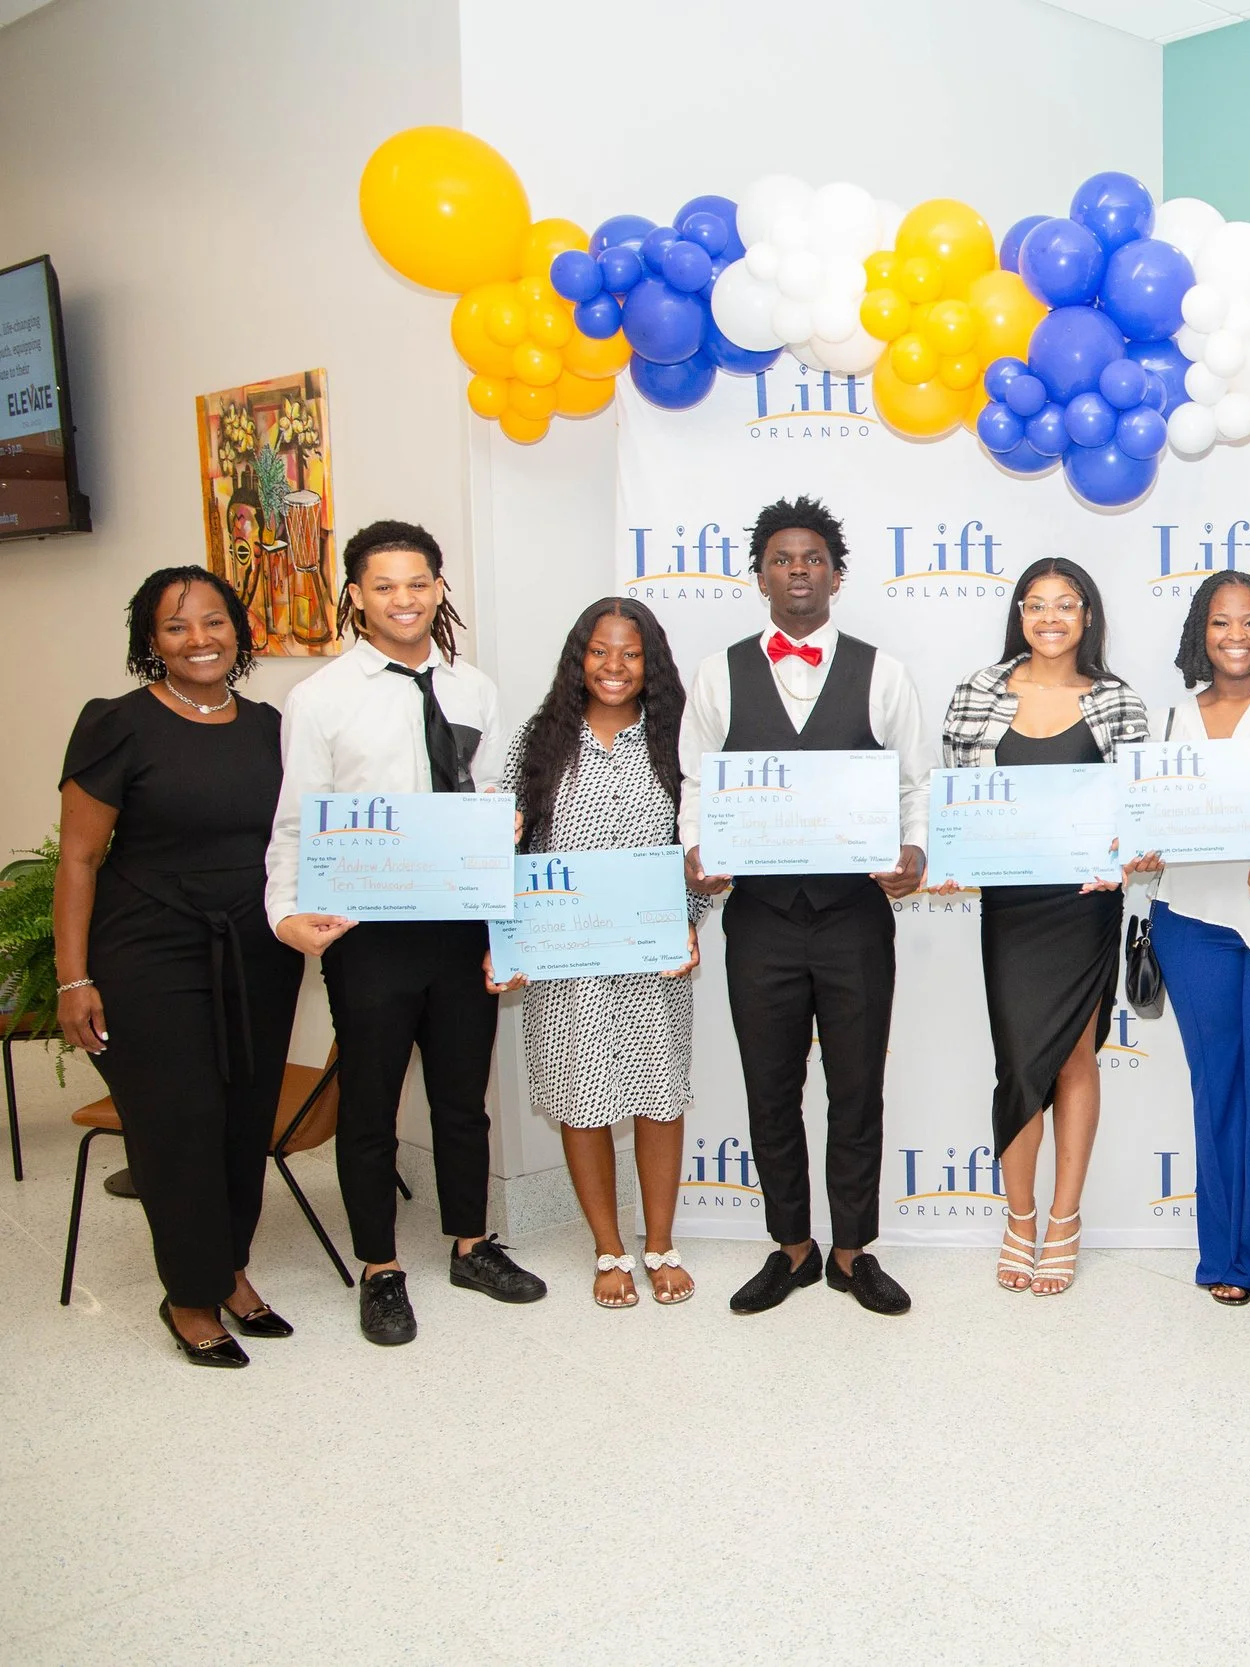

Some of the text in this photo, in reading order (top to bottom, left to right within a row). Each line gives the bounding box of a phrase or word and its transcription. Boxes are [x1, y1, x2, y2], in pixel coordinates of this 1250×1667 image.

[755, 364, 868, 418] Lift
[8, 384, 52, 416] ELEVATE
[750, 426, 869, 438] ORLANDO
[628, 523, 741, 578] Lift
[886, 520, 1004, 578] Lift
[628, 587, 743, 599] ORLANDO
[887, 586, 1005, 598] ORLANDO
[1129, 744, 1205, 781] Lift
[713, 756, 793, 791] Lift
[942, 770, 1017, 805] Lift
[1128, 782, 1206, 794] ORLANDO
[712, 795, 793, 804] ORLANDO
[314, 796, 400, 832] Lift
[940, 808, 1018, 817] ORLANDO
[312, 838, 401, 847] ORLANDO
[327, 875, 414, 892] Ten Thousand
[526, 858, 578, 892] ift
[382, 904, 417, 912] Scholarship
[892, 901, 972, 913] ORLAN
[573, 913, 614, 930] Holden
[515, 938, 590, 953] Ten Thousand
[687, 1137, 760, 1189] ift
[898, 1145, 1007, 1197] Lift
[683, 1195, 760, 1208] LANDO
